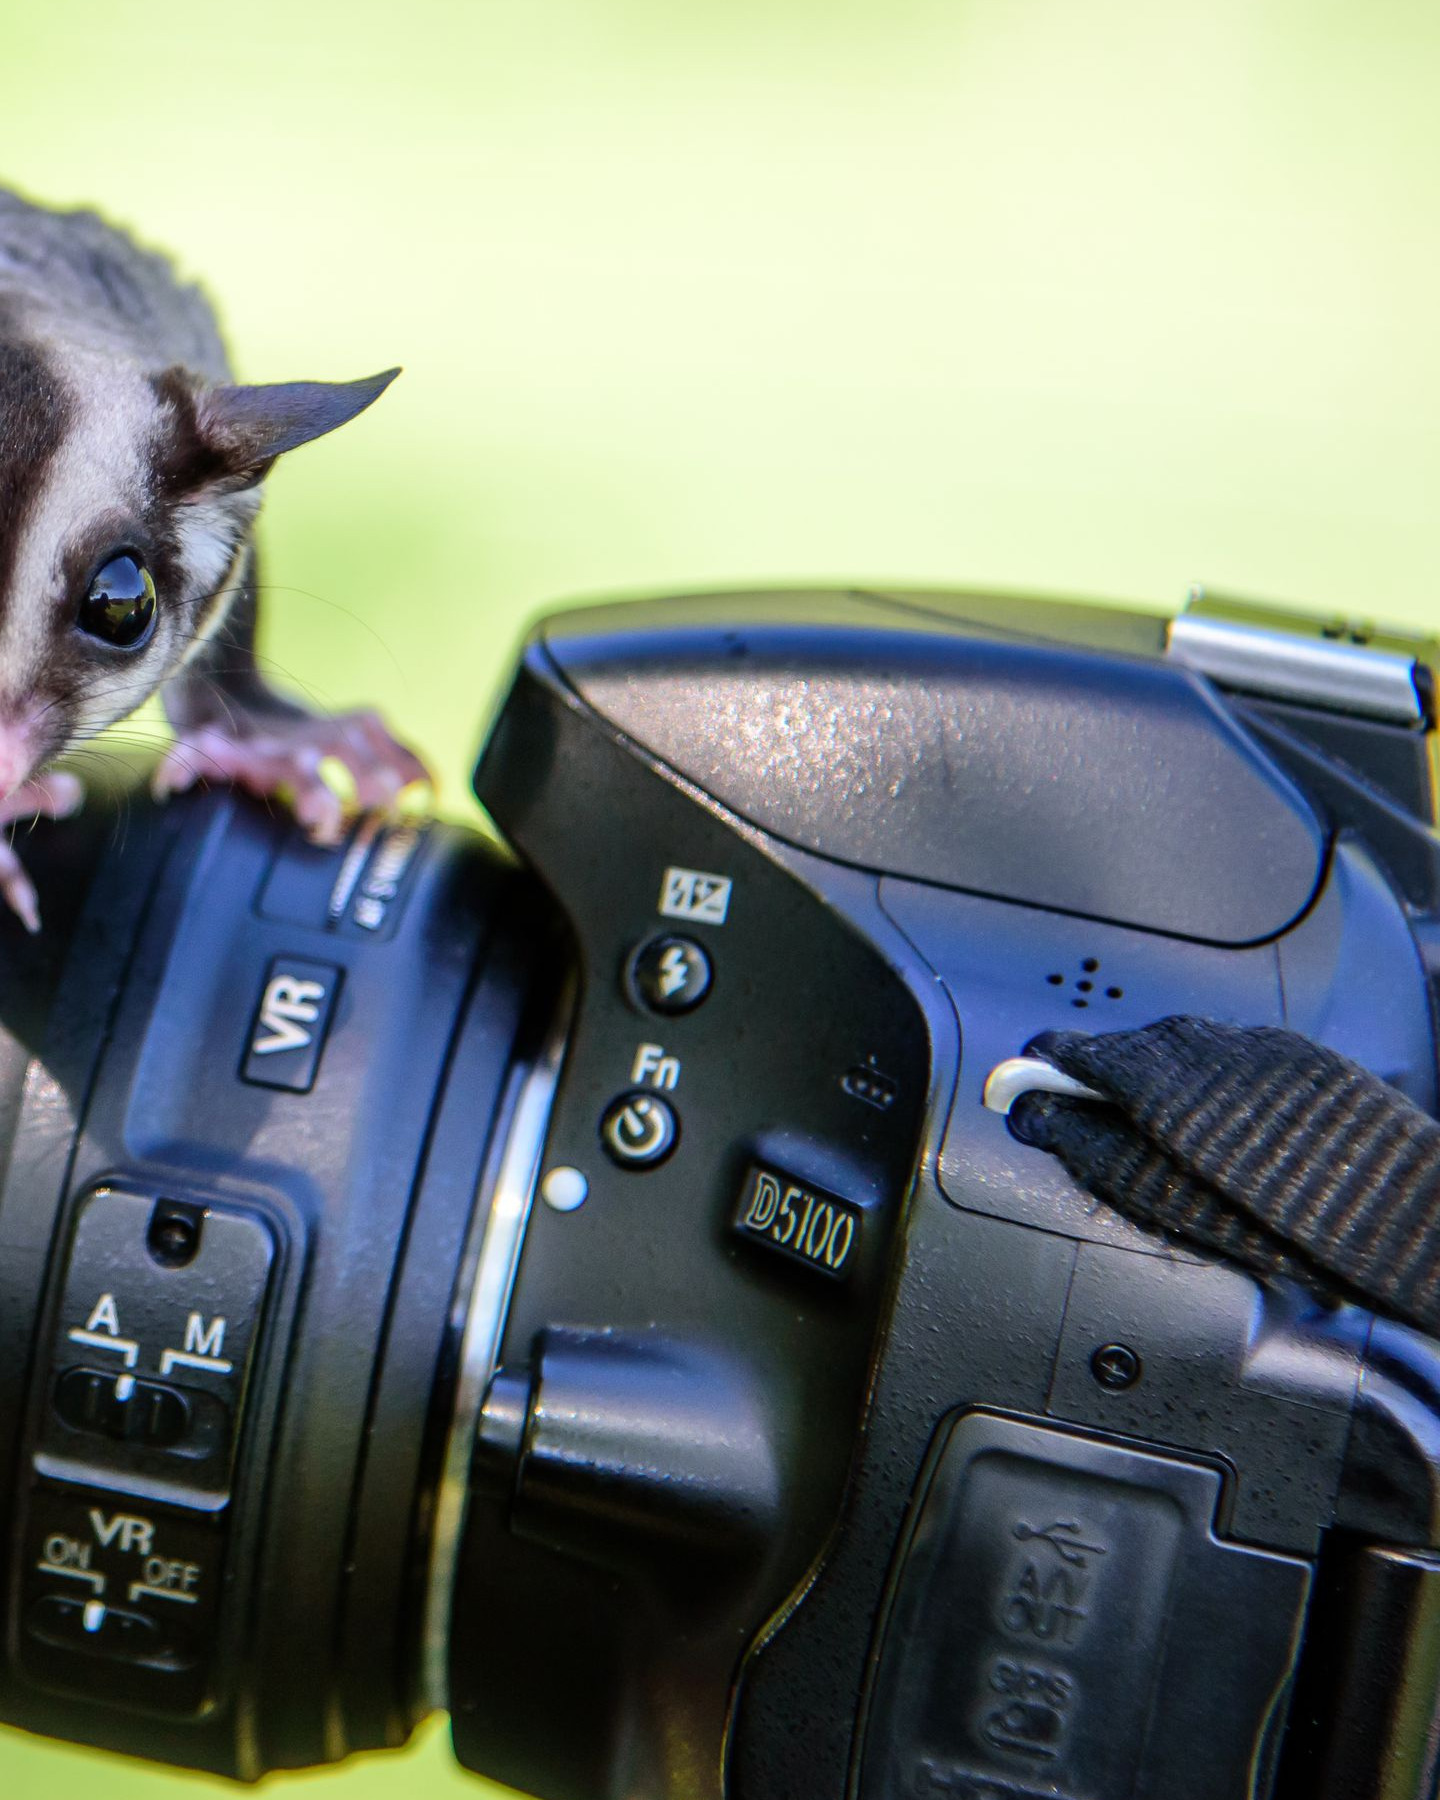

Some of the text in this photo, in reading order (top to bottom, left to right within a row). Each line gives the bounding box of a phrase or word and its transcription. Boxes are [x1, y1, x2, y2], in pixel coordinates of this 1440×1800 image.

[252, 973, 325, 1055] VR
[631, 1042, 681, 1090] Fn
[745, 1171, 855, 1269] D5100
[86, 1294, 121, 1337] A
[185, 1312, 227, 1358] M
[44, 1536, 91, 1569] ON
[90, 1508, 155, 1555] VR
[147, 1556, 200, 1590] OFF
